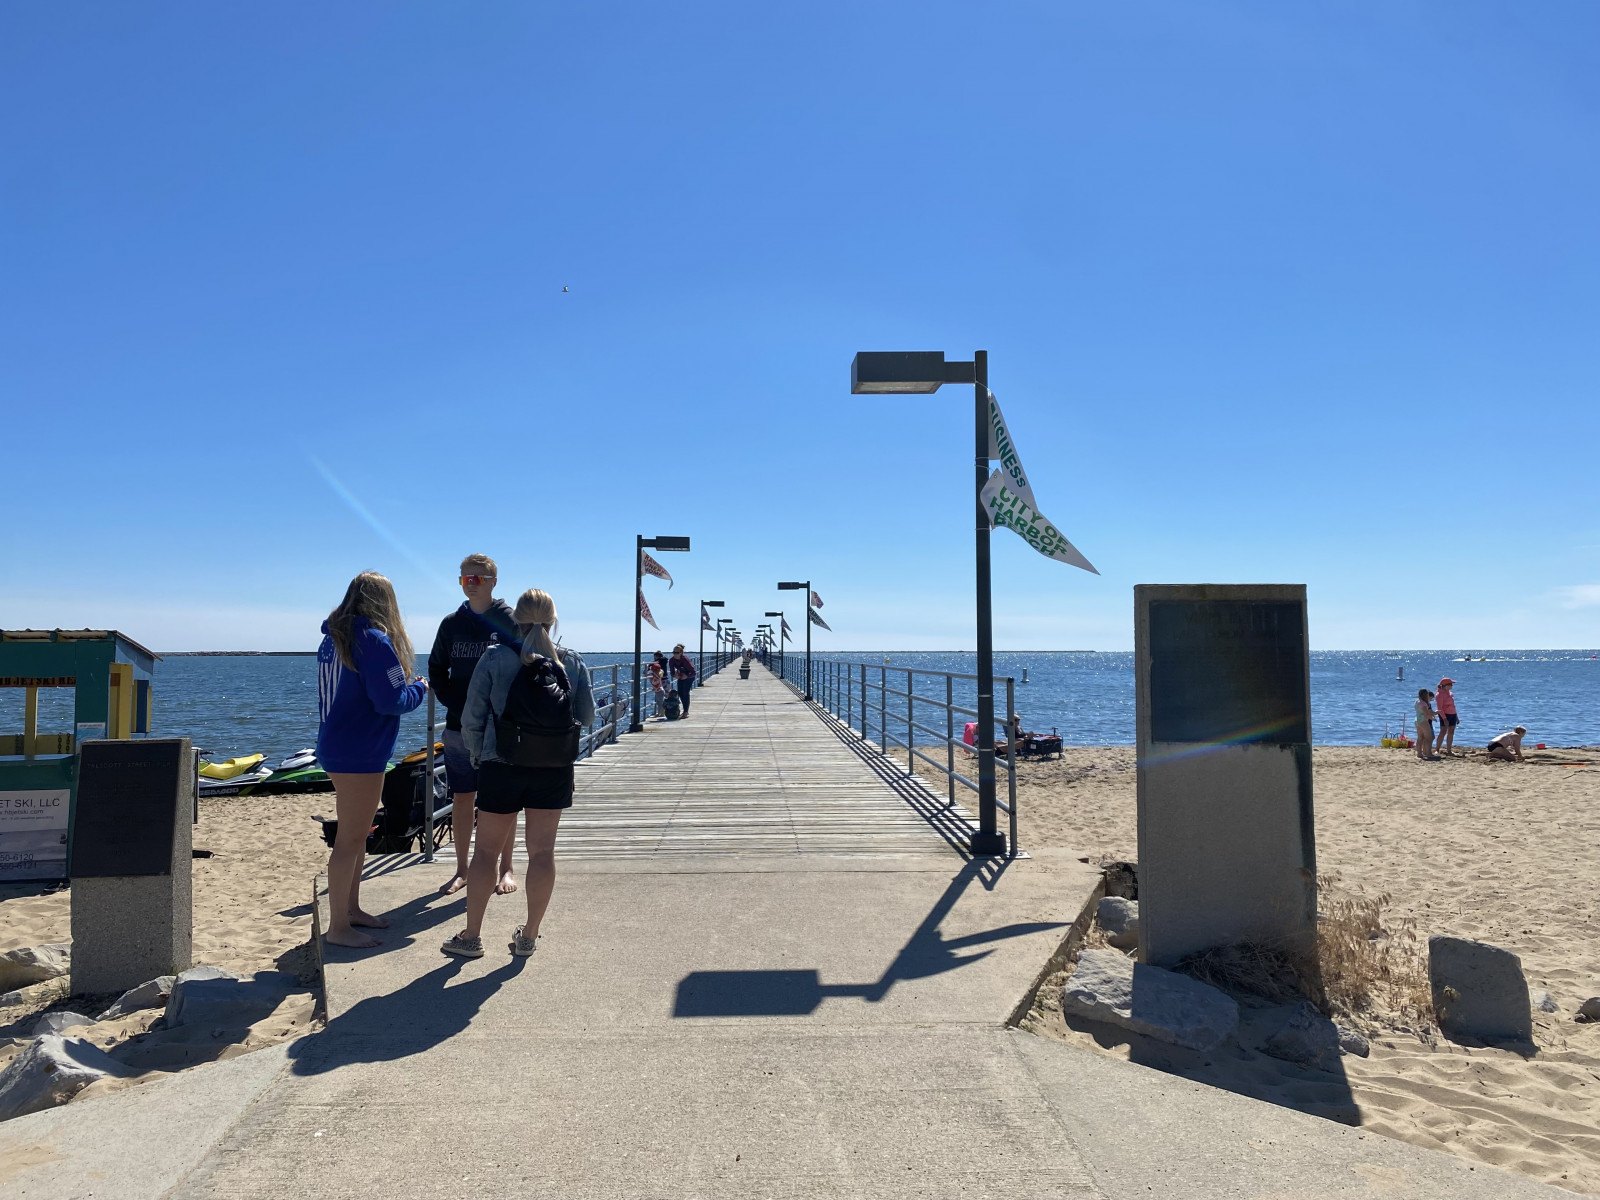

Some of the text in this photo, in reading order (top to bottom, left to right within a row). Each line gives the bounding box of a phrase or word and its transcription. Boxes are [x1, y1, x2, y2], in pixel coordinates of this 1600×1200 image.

[990, 496, 1067, 555] HARBOR
[1000, 486, 1068, 546] CITY OF
[14, 799, 36, 809] SKI,
[39, 798, 60, 807] LLC
